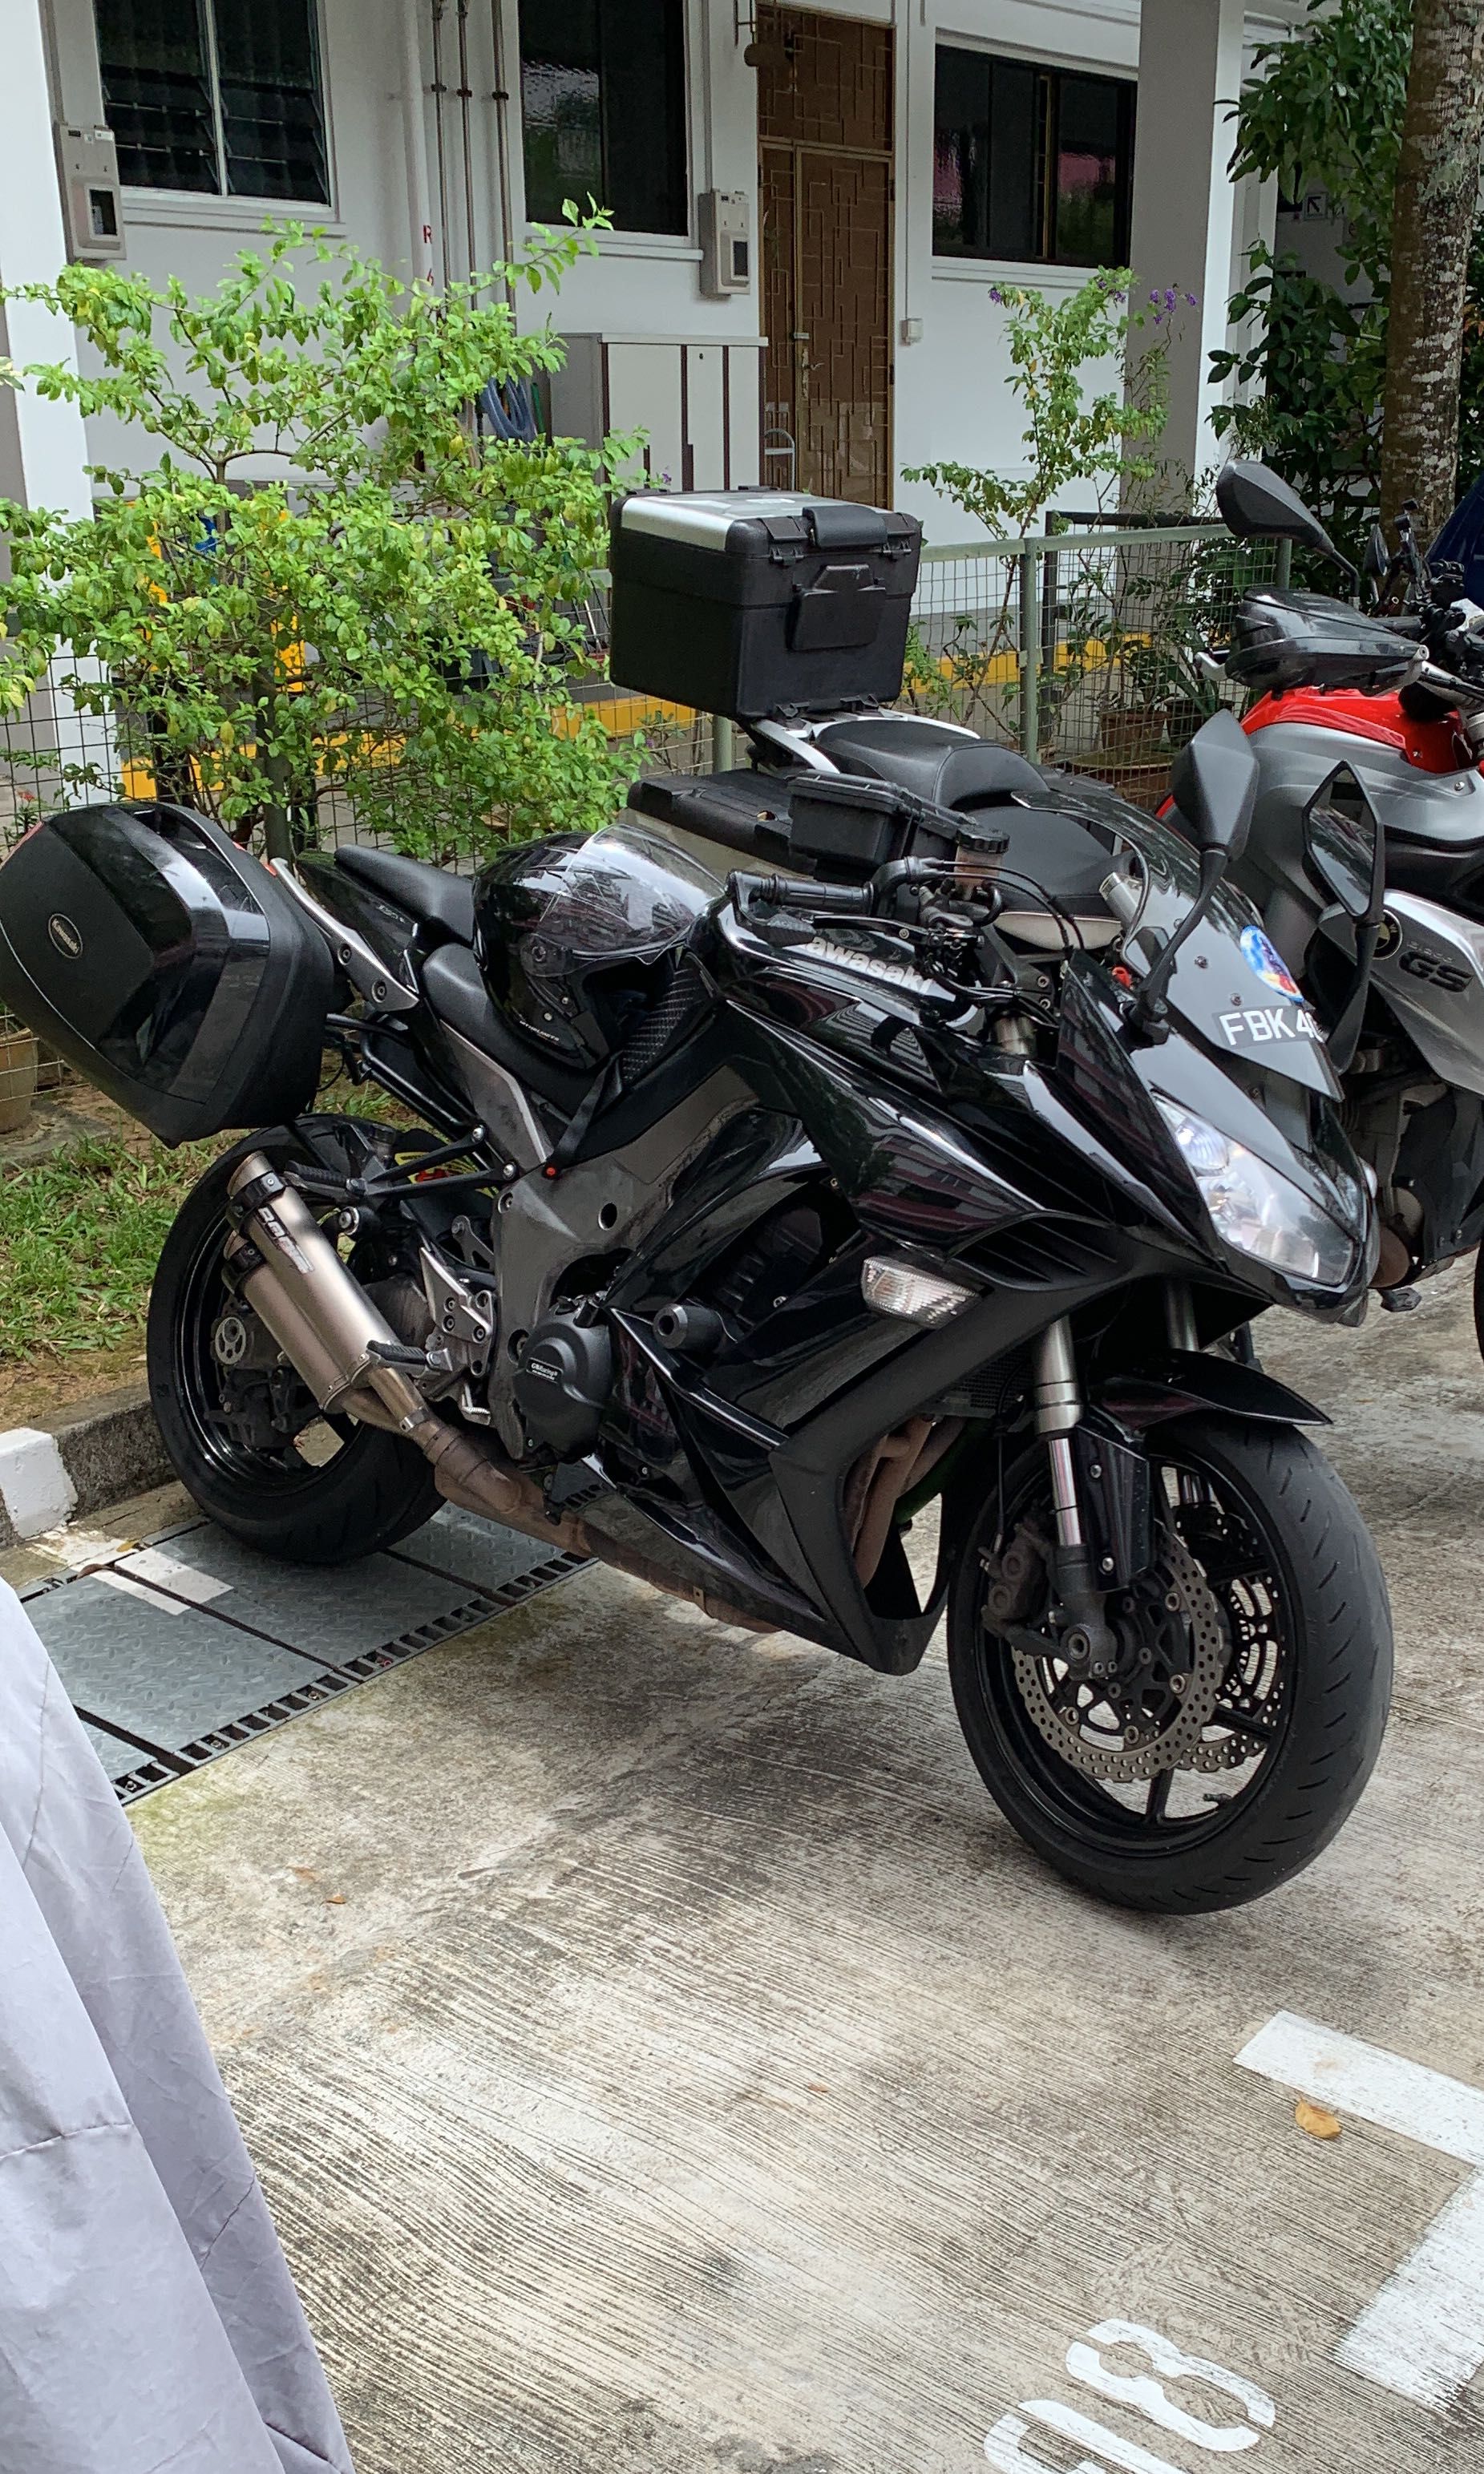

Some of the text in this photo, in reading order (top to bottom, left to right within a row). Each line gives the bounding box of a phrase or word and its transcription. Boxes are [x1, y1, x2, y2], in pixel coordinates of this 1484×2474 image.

[423, 224, 433, 244] R
[804, 936, 934, 995] awasaki
[1398, 951, 1474, 992] GS
[1219, 1008, 1296, 1045] FBK
